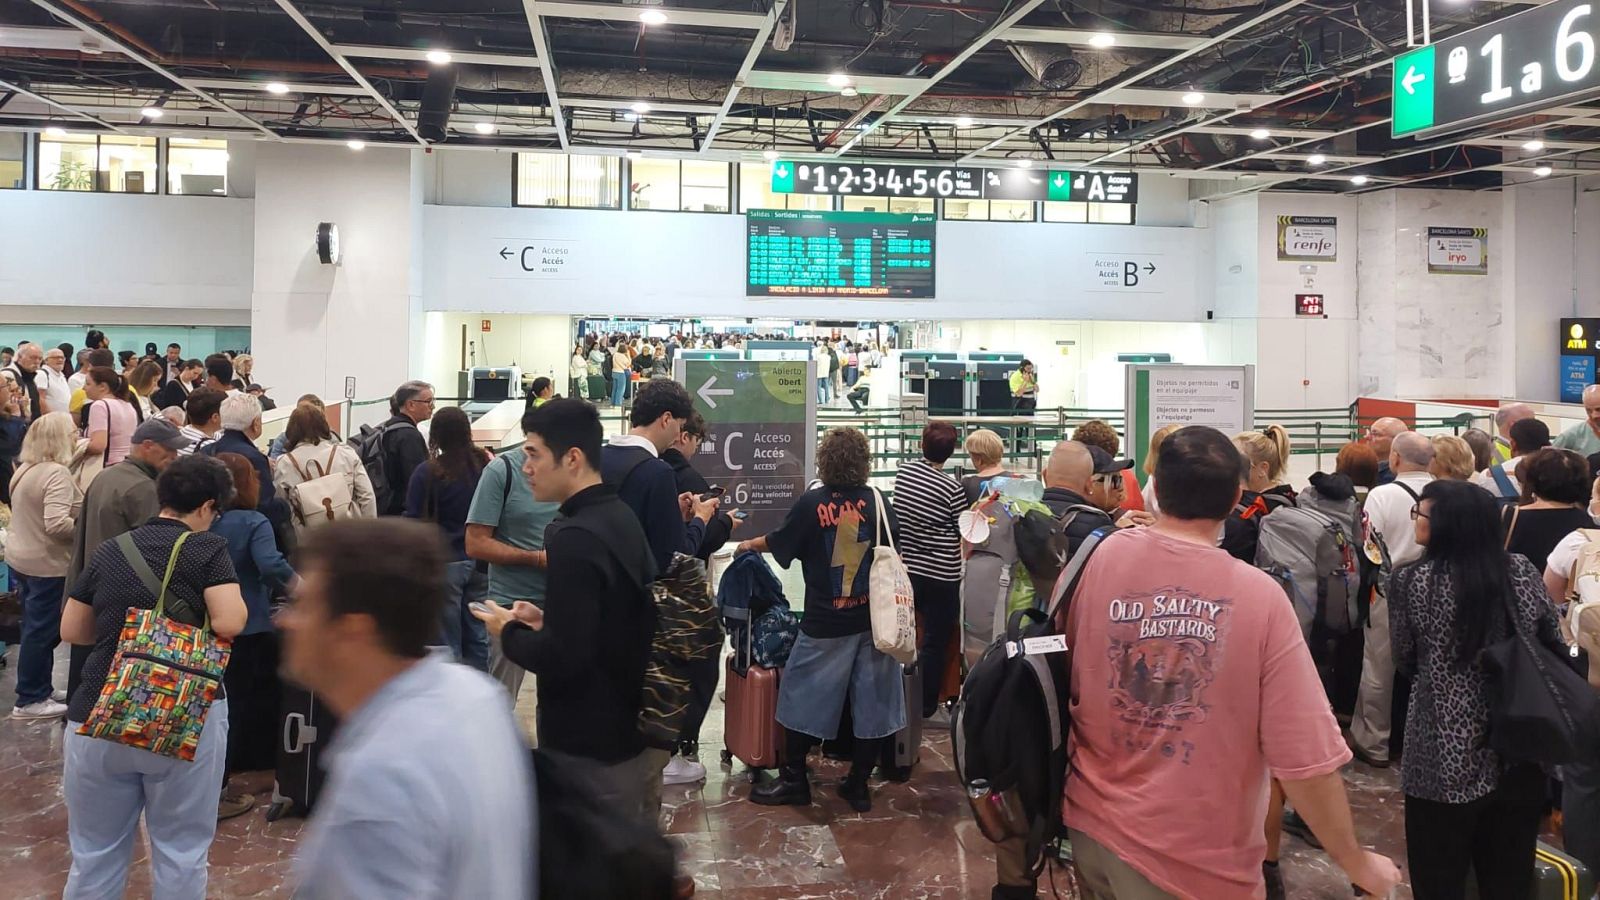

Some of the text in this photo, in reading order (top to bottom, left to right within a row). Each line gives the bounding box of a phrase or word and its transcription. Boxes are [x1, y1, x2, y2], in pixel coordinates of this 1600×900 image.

[1480, 4, 1595, 104] 1 a 6
[1088, 175, 1105, 200] A
[1108, 175, 1132, 184] Acceso
[1294, 238, 1332, 254] renfe
[521, 246, 534, 272] C
[1448, 252, 1467, 263] iryo
[1124, 261, 1139, 286] B
[1567, 339, 1587, 349] ATM
[754, 433, 791, 443] Acceso
[724, 432, 743, 470] C
[754, 448, 784, 458] Accés
[725, 483, 748, 504] a 6
